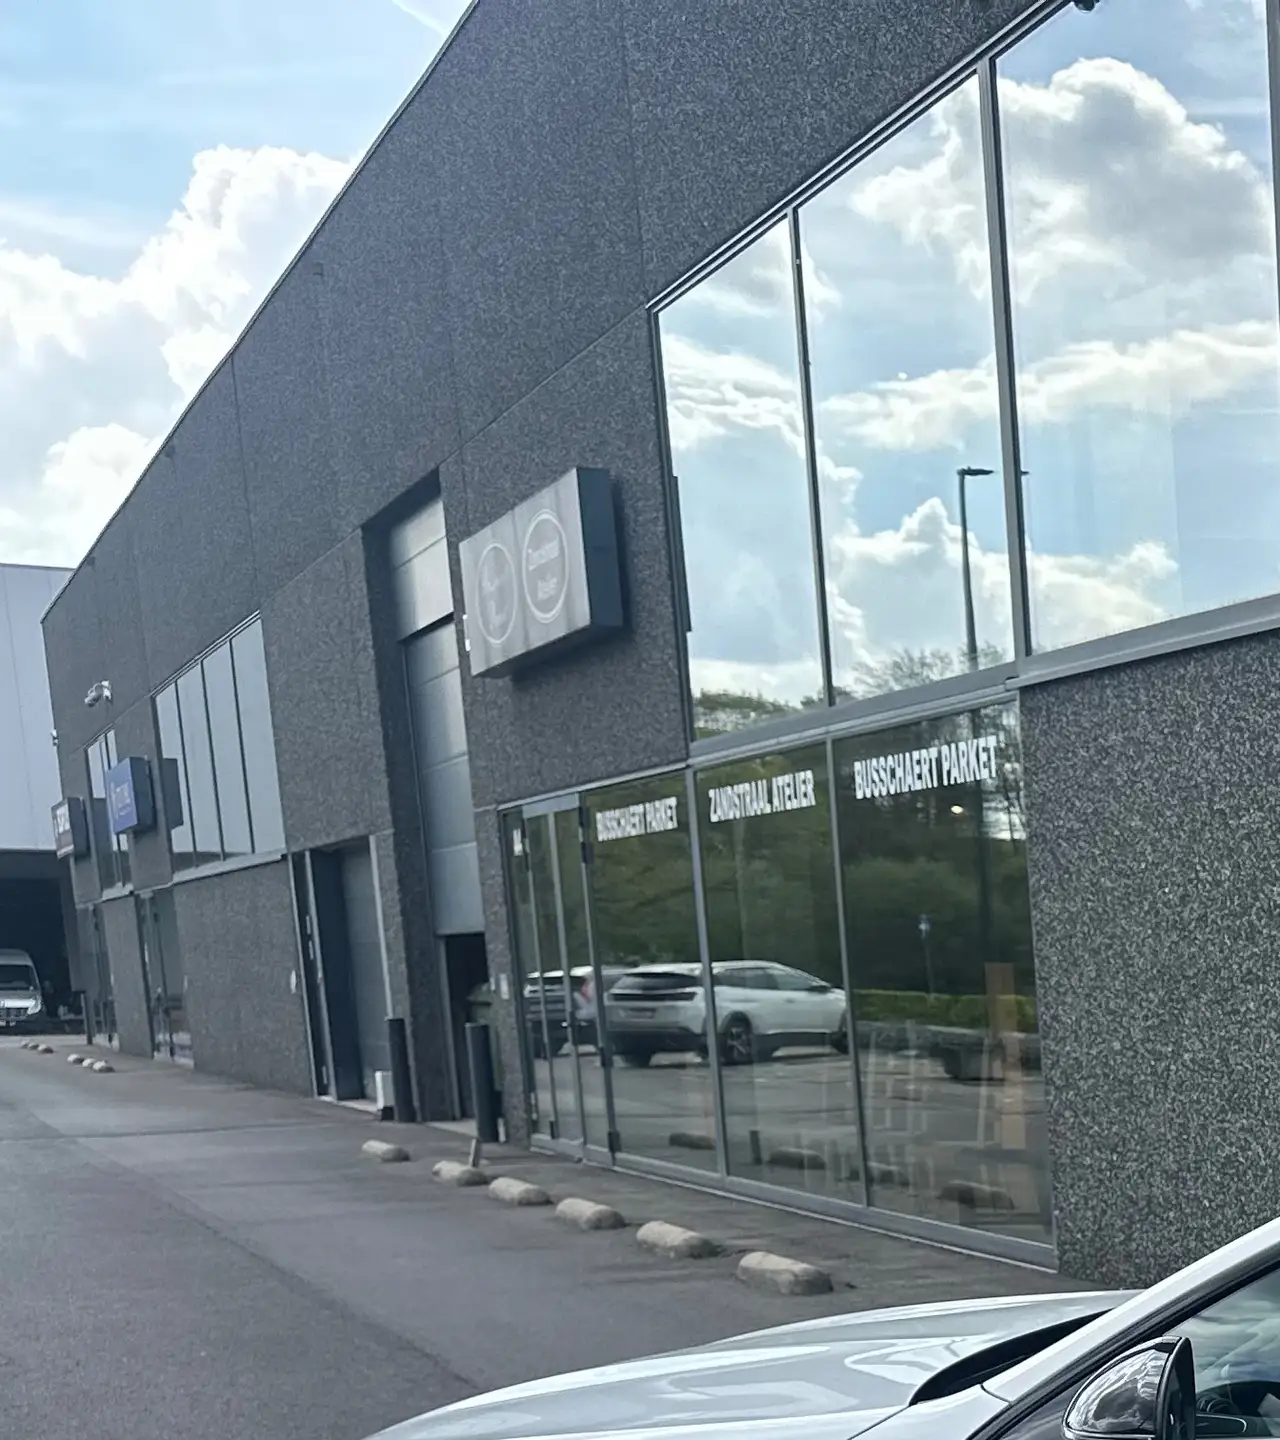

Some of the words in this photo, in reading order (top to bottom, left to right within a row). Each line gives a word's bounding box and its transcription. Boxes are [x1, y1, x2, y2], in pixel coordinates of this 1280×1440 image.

[708, 778, 771, 823] ZANDSTRAAL
[772, 769, 816, 813] ATELIER
[853, 747, 938, 800] BUSSCHAERT
[941, 735, 997, 787] PARKET
